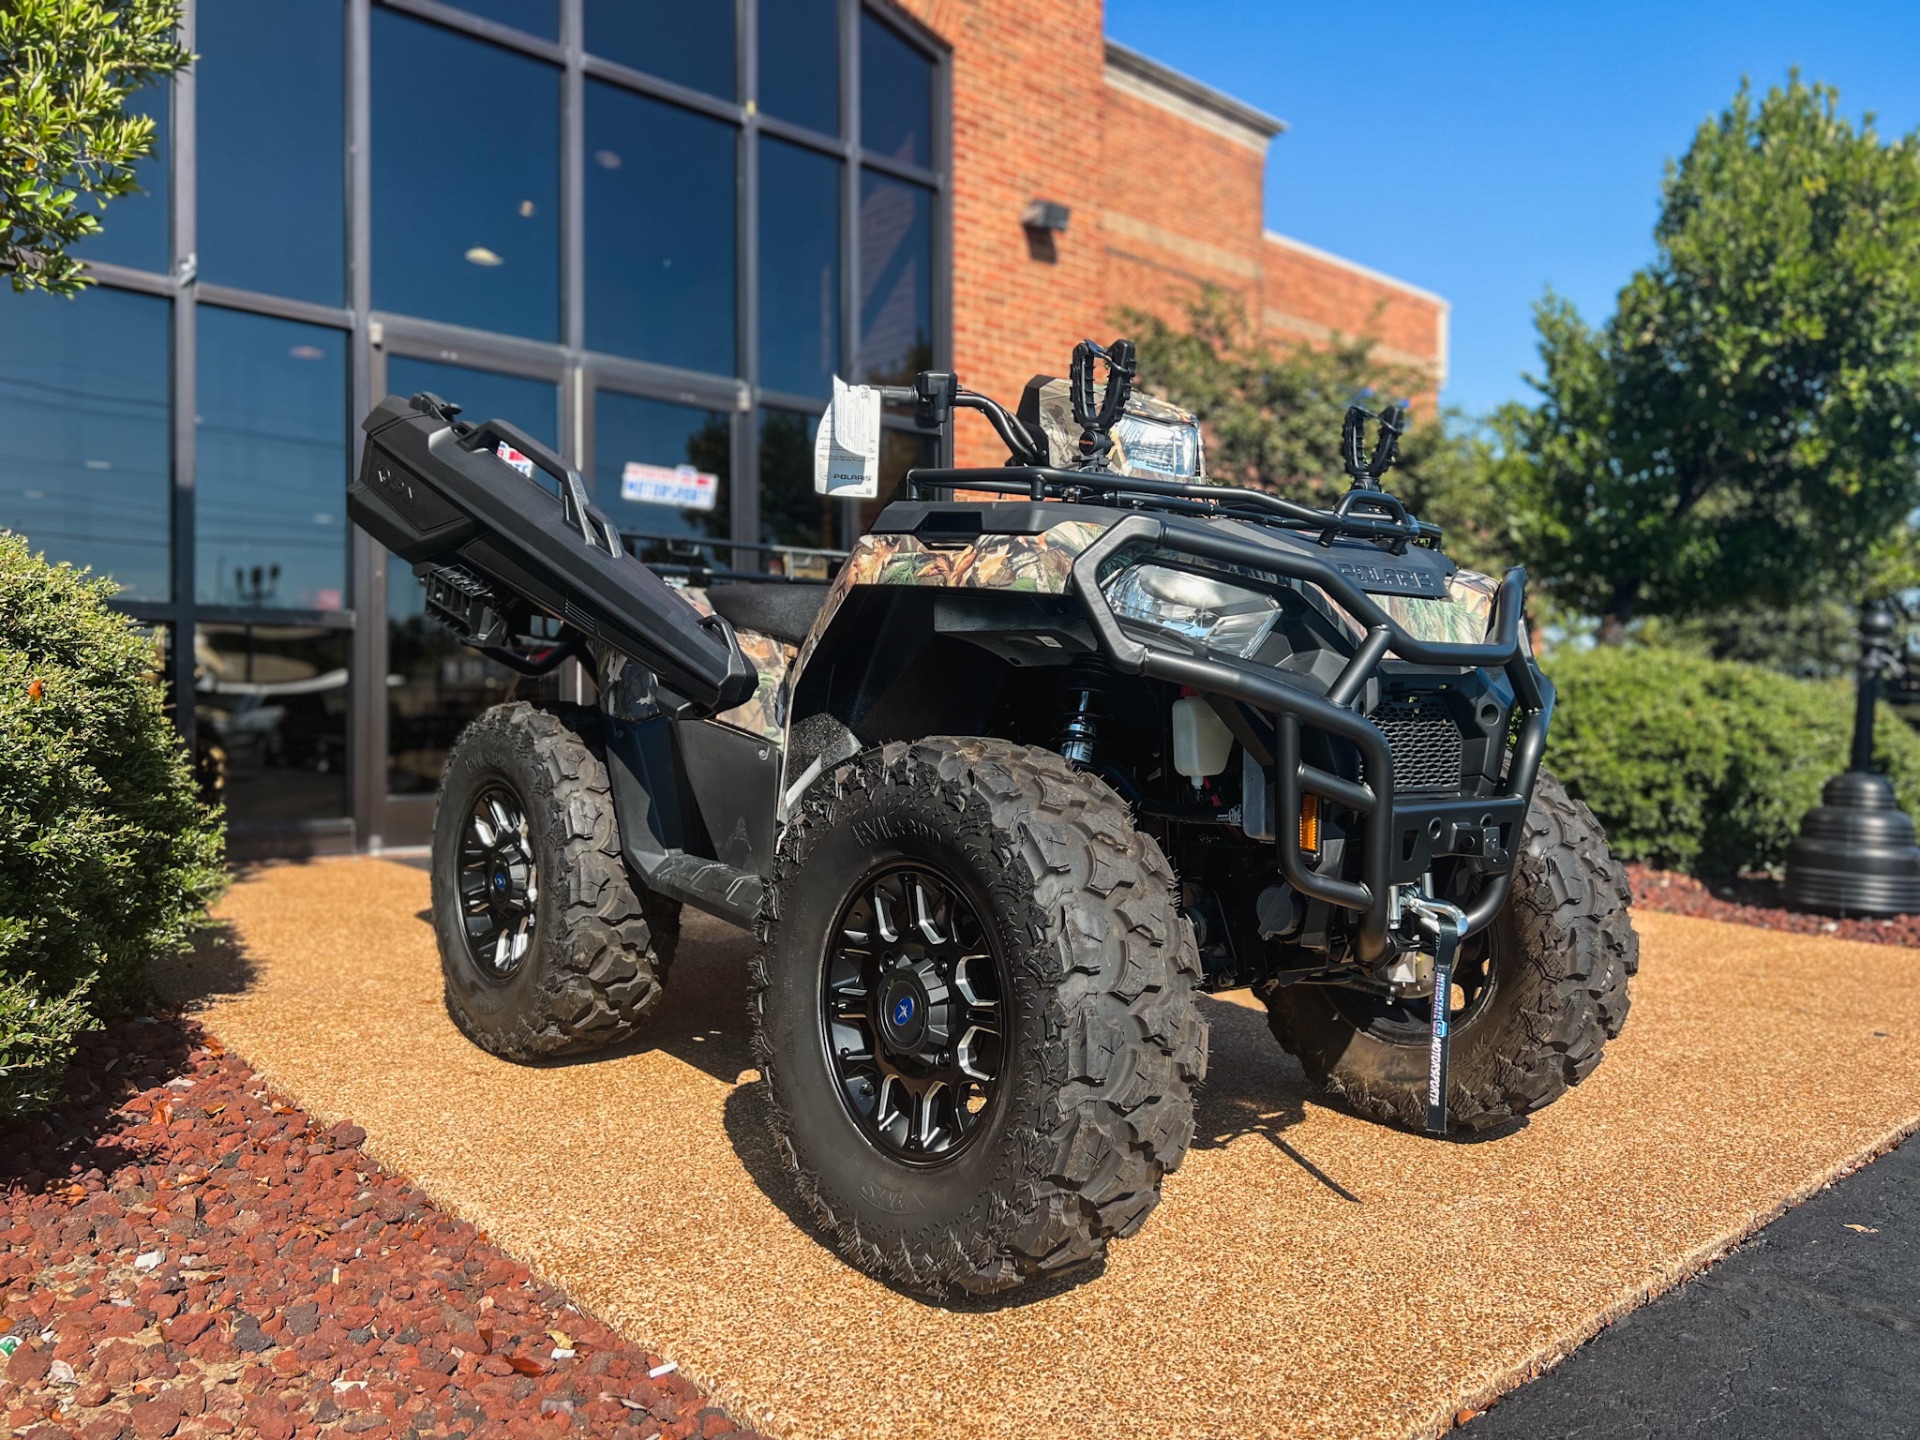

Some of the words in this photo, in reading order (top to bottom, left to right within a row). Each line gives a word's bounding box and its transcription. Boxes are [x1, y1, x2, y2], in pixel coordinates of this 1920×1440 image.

[833, 473, 872, 482] POLARIS
[1336, 563, 1434, 588] POLARIS
[1434, 972, 1446, 1021] INTERSTATE
[1430, 1037, 1441, 1106] MOTORSPORTS
